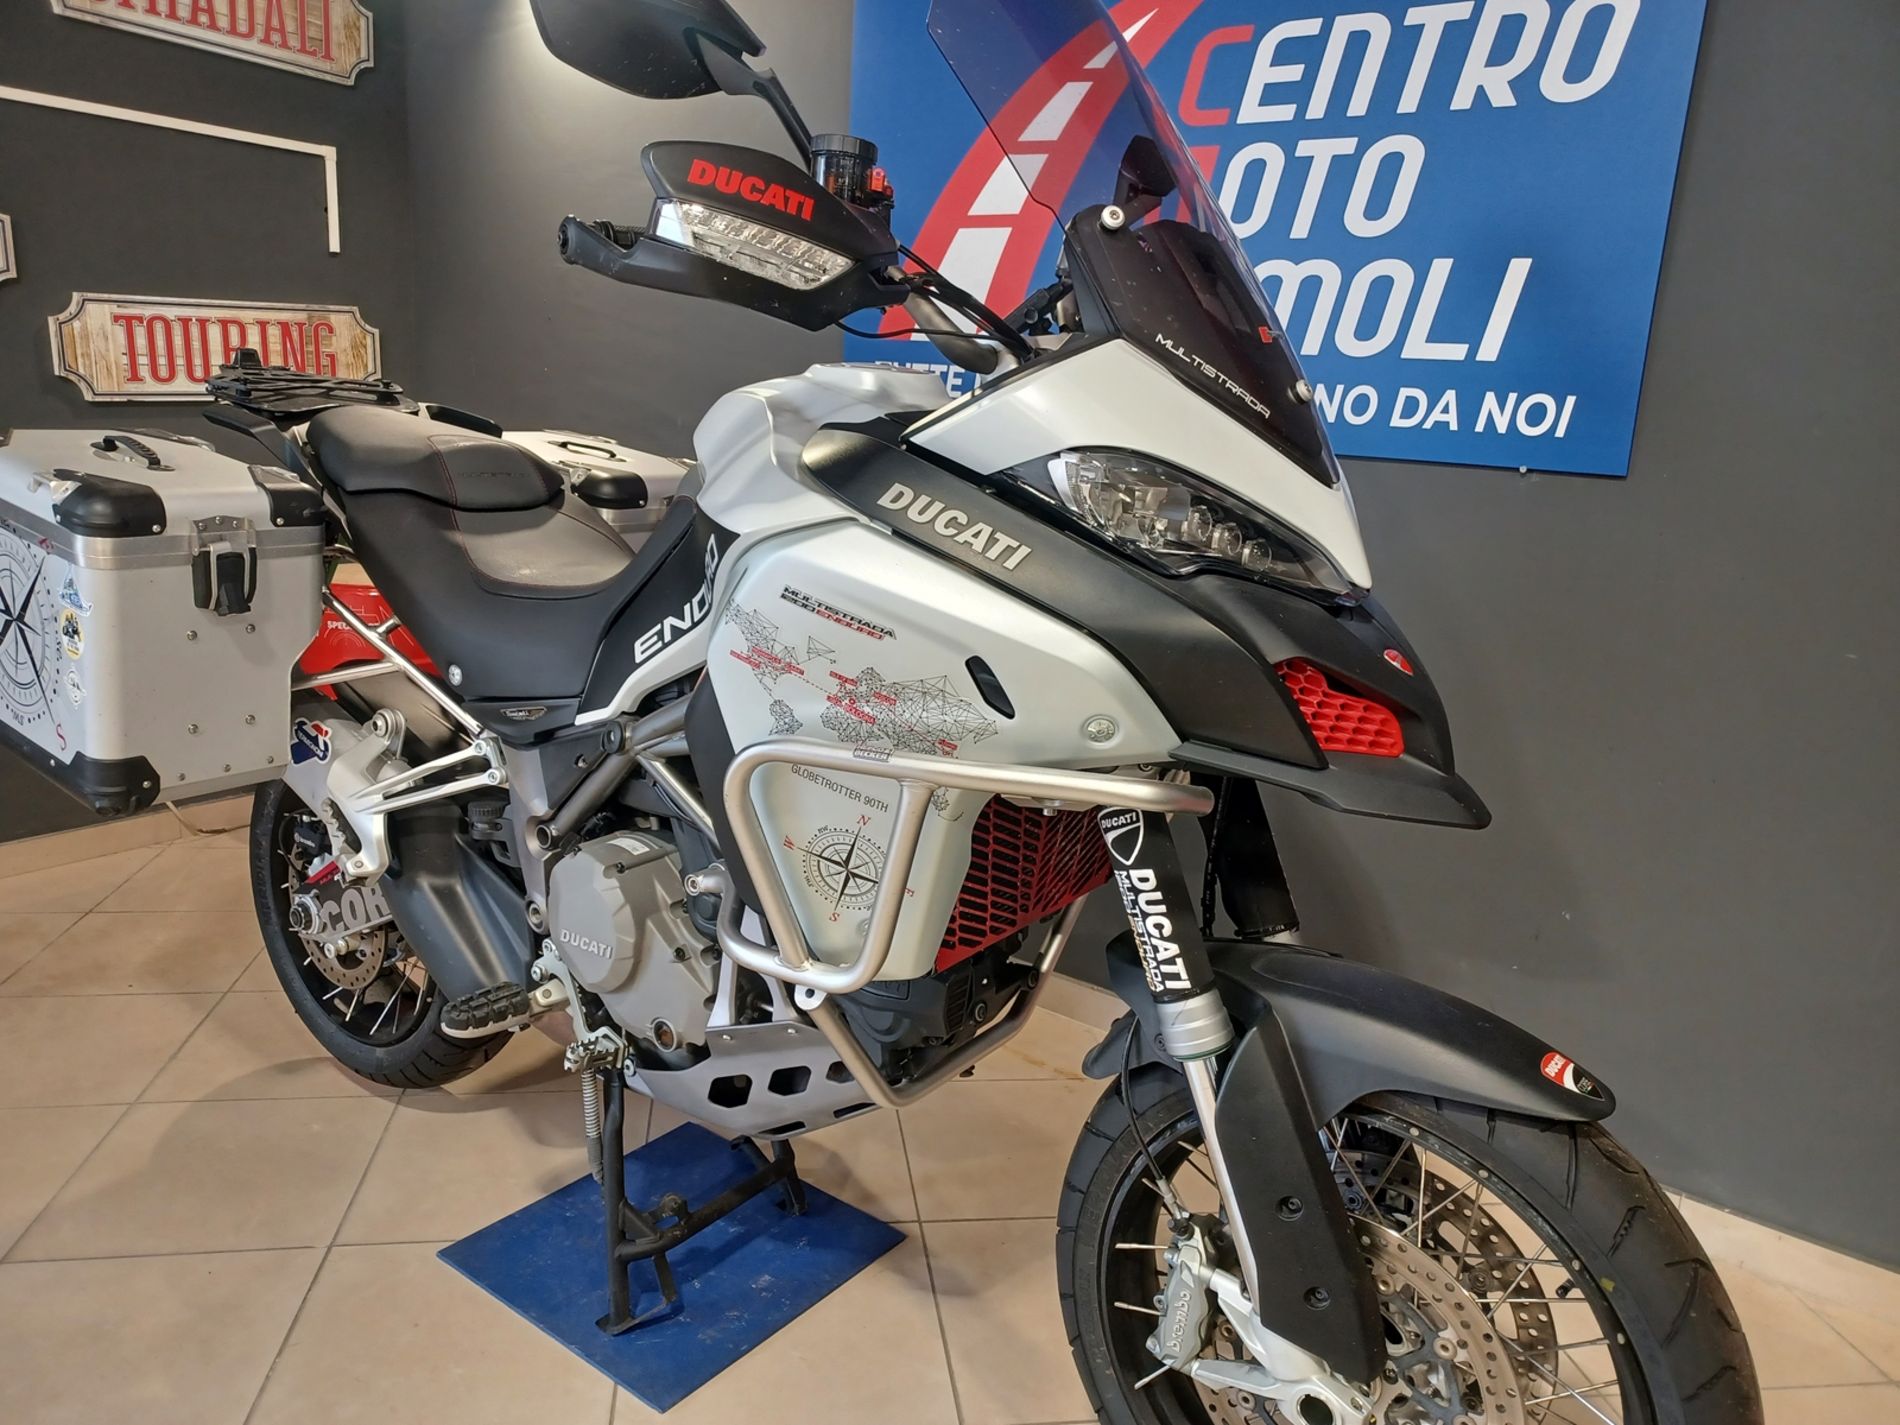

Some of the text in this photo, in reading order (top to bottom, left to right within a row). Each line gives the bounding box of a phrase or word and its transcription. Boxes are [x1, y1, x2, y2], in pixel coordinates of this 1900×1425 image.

[1180, 0, 1640, 126] CENTRO
[687, 158, 814, 221] DUCATI
[1252, 257, 1533, 362] MOLI
[1155, 333, 1271, 419] MULTISTRADA
[1389, 387, 1458, 431] DA
[1474, 391, 1577, 438] NOI
[876, 482, 1033, 571] DUCATI
[782, 584, 897, 640] MULTISTRADA
[791, 763, 889, 813] GLOBETROTTER 90TH
[856, 814, 871, 827] N
[1101, 811, 1138, 829] DUCATI
[559, 928, 613, 959] DUCATI
[1117, 869, 1166, 993] MULTISTRADA
[1128, 868, 1192, 990] DUCATI
[1167, 1289, 1192, 1353] brembo
